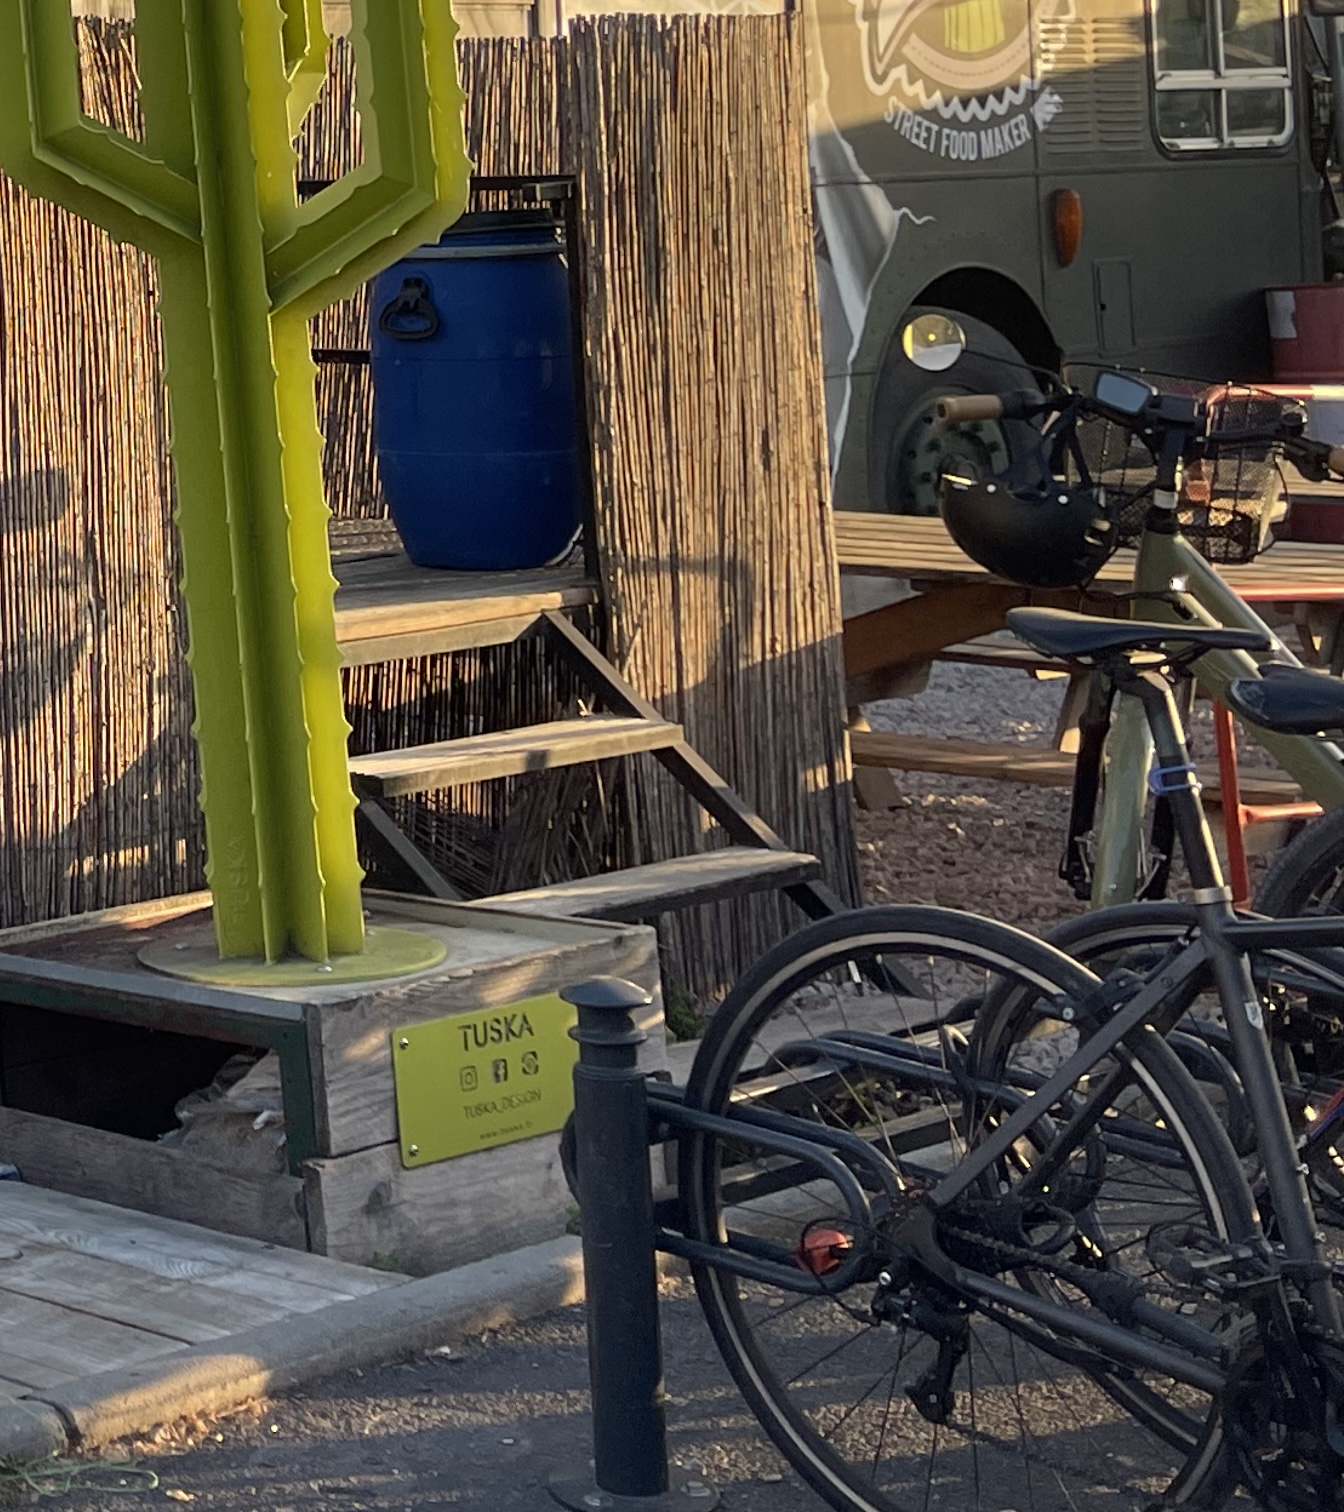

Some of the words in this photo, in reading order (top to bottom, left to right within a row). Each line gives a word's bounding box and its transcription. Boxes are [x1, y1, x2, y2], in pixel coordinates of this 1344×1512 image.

[883, 95, 940, 154] STREET
[939, 126, 979, 161] FOOD
[978, 112, 1032, 160] MAKER
[457, 1011, 535, 1052] TUSKA
